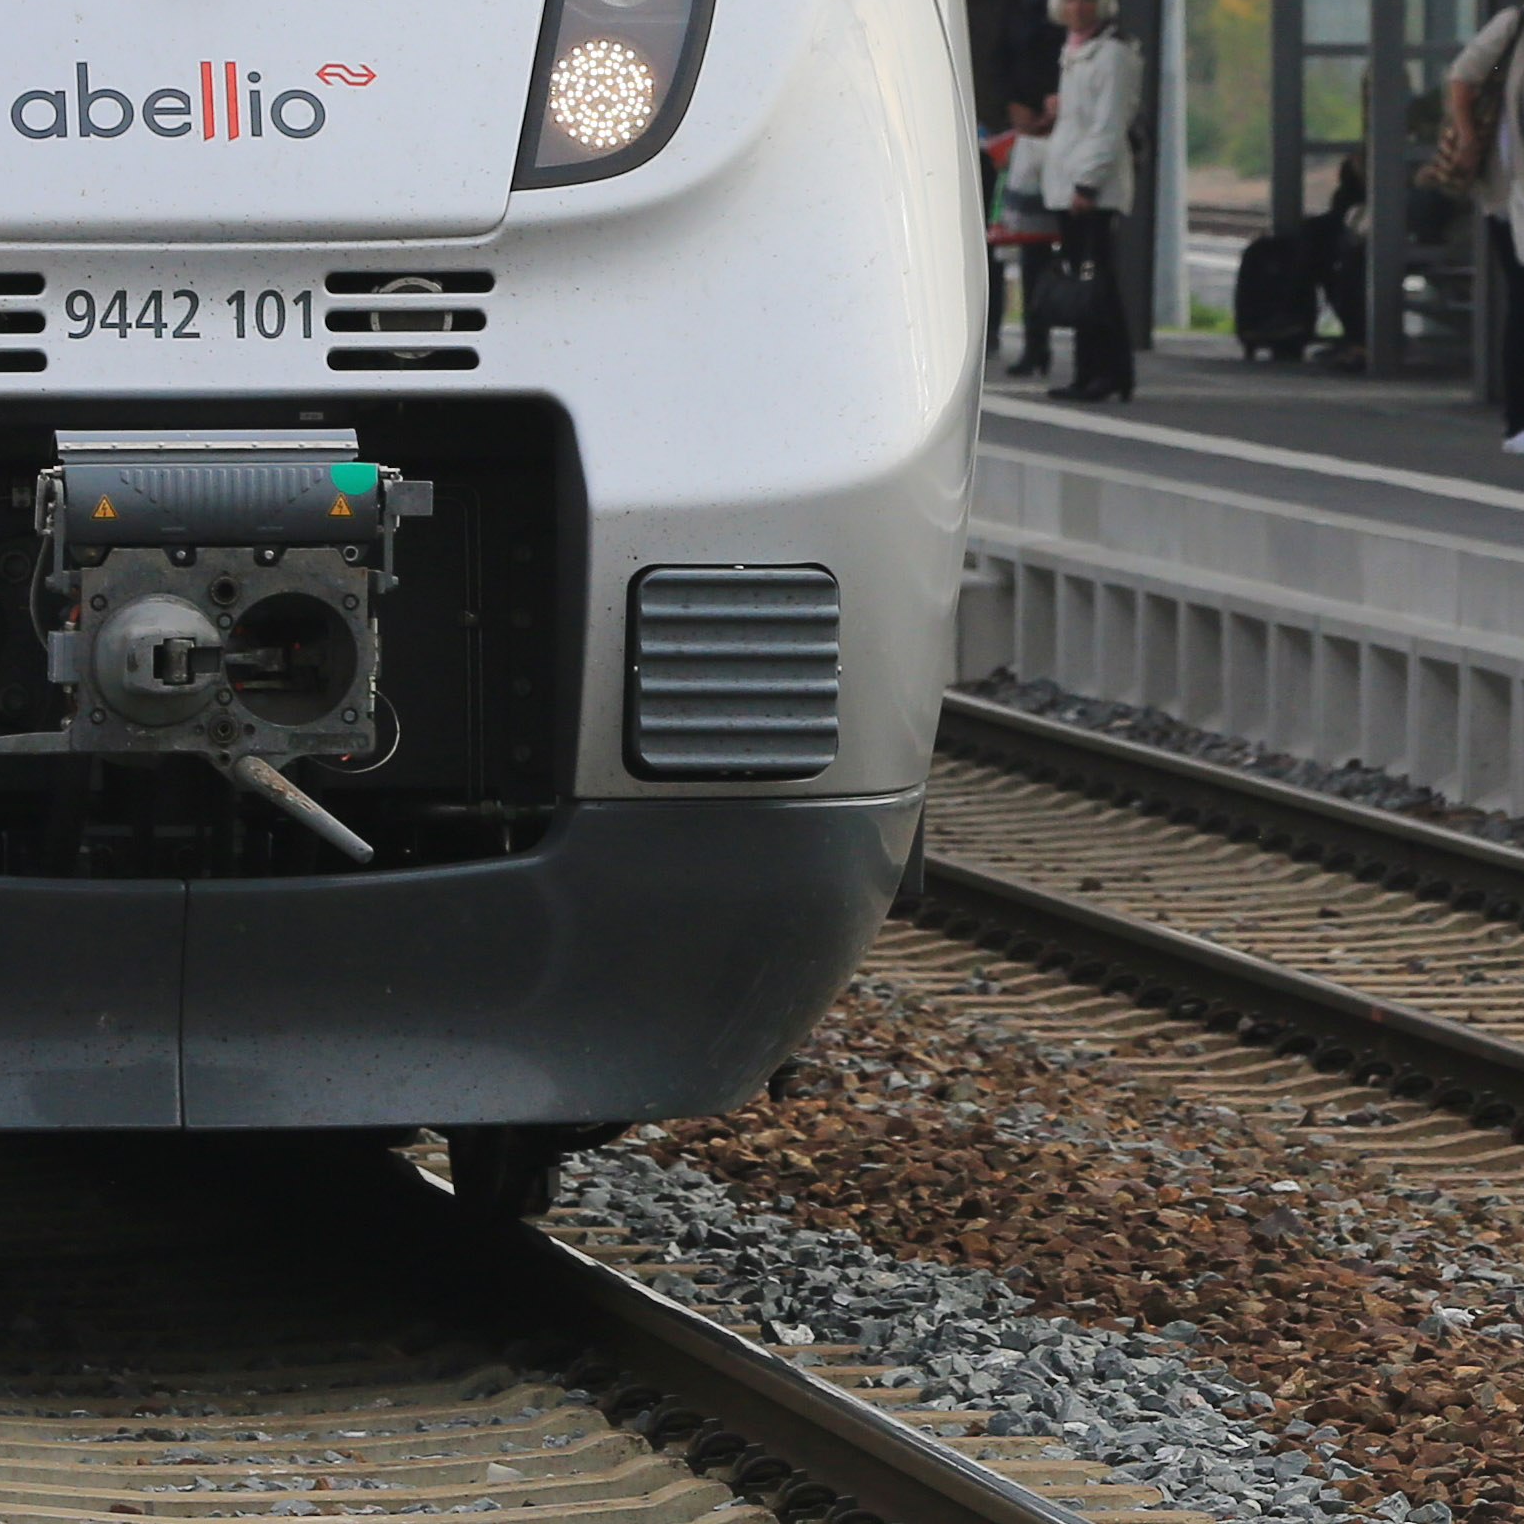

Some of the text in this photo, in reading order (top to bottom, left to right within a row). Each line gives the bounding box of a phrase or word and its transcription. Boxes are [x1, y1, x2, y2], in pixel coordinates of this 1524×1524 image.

[10, 61, 326, 142] abellio
[65, 288, 314, 340] 9442 101
